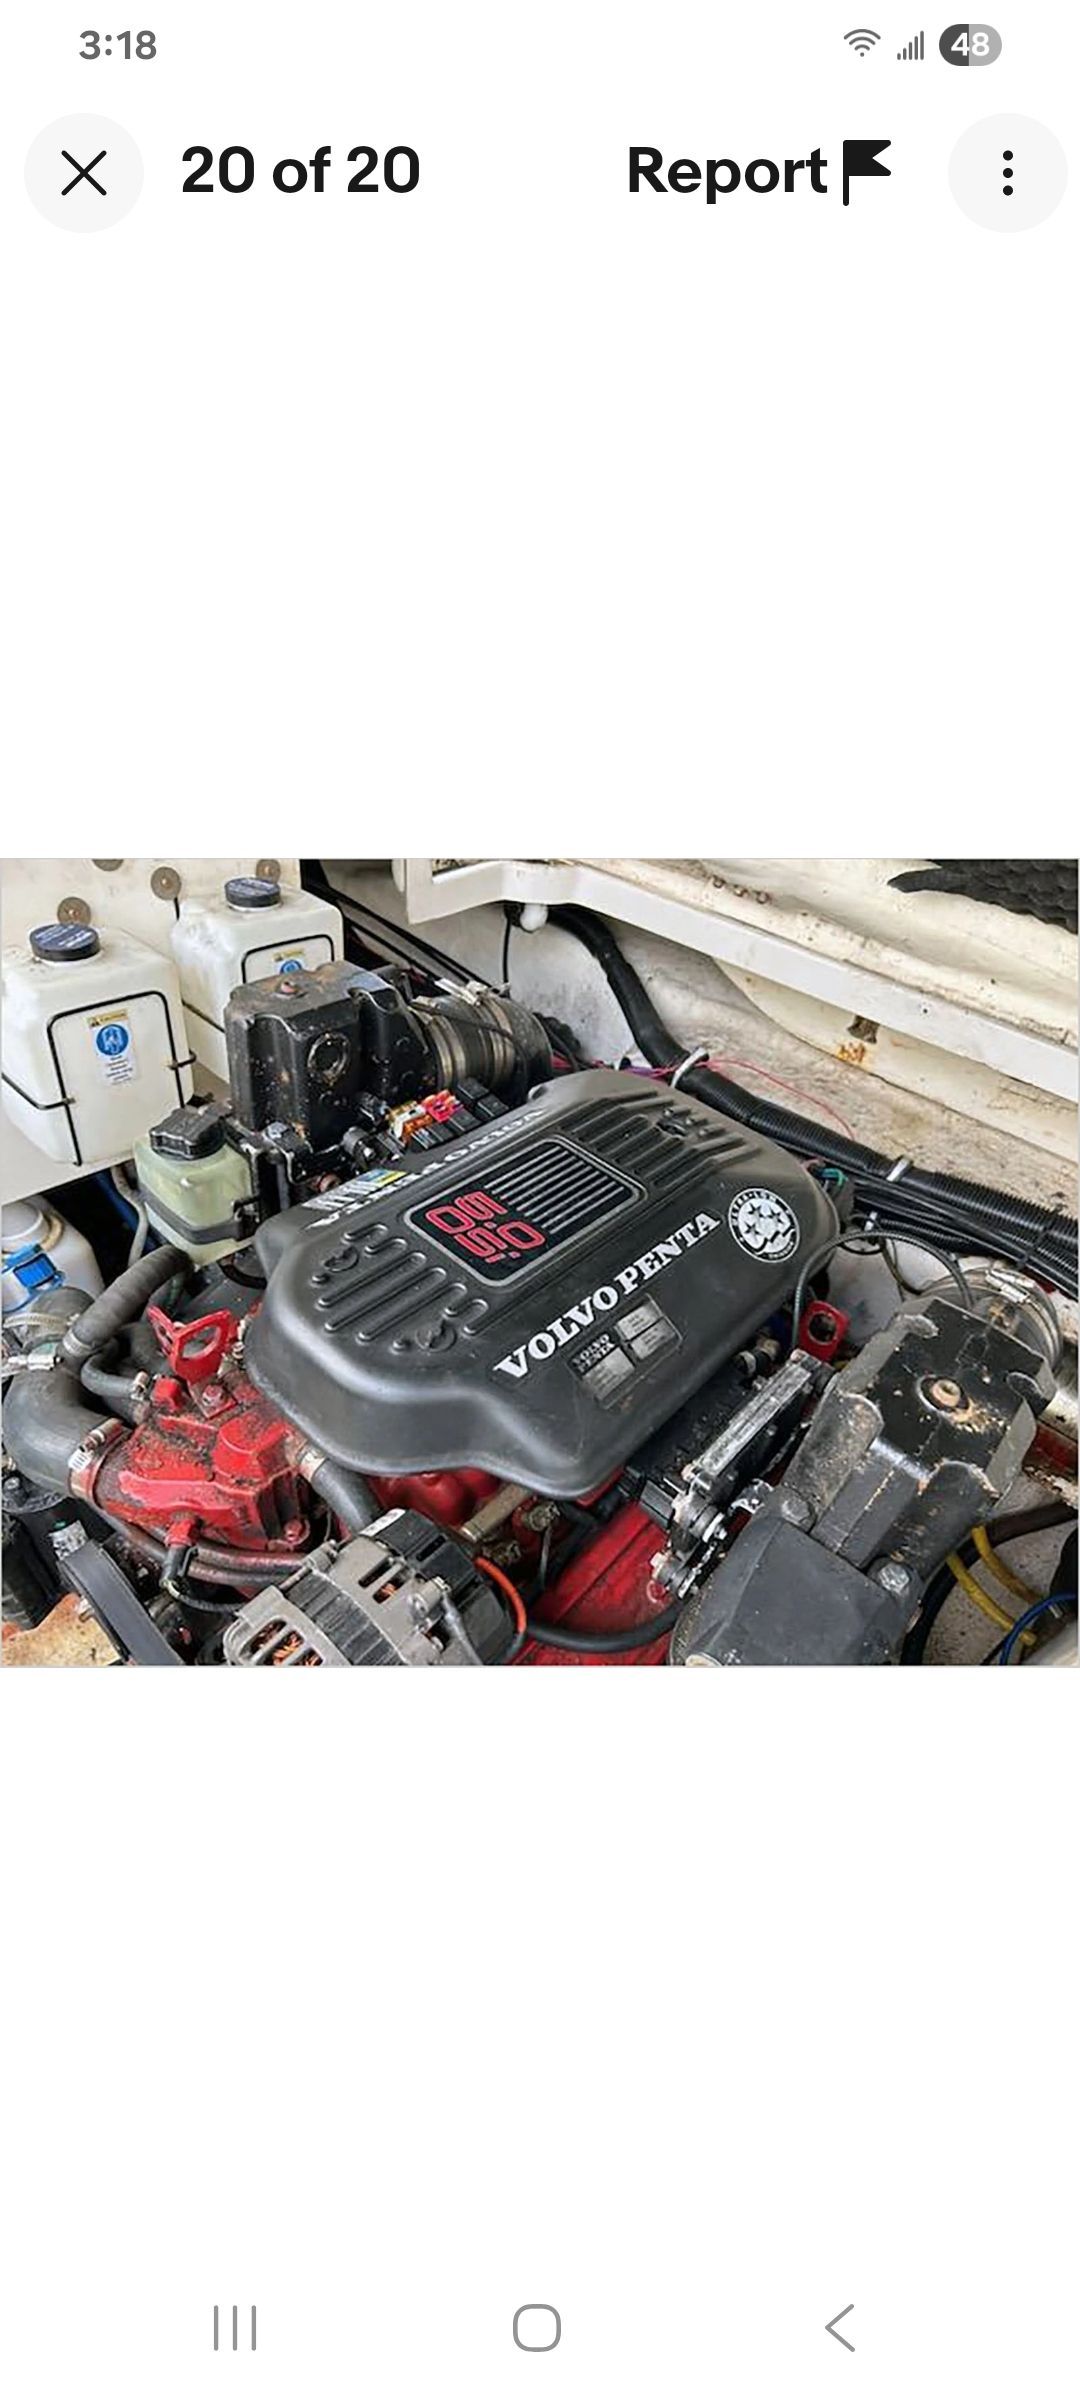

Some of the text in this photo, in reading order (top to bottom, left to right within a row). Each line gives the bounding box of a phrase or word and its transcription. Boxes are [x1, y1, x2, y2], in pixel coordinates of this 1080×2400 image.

[79, 30, 157, 60] 3:18
[951, 32, 990, 57] 48
[182, 145, 420, 194] 20 of 20
[629, 146, 828, 205] Report
[493, 1212, 721, 1379] VOLVO PENTA
